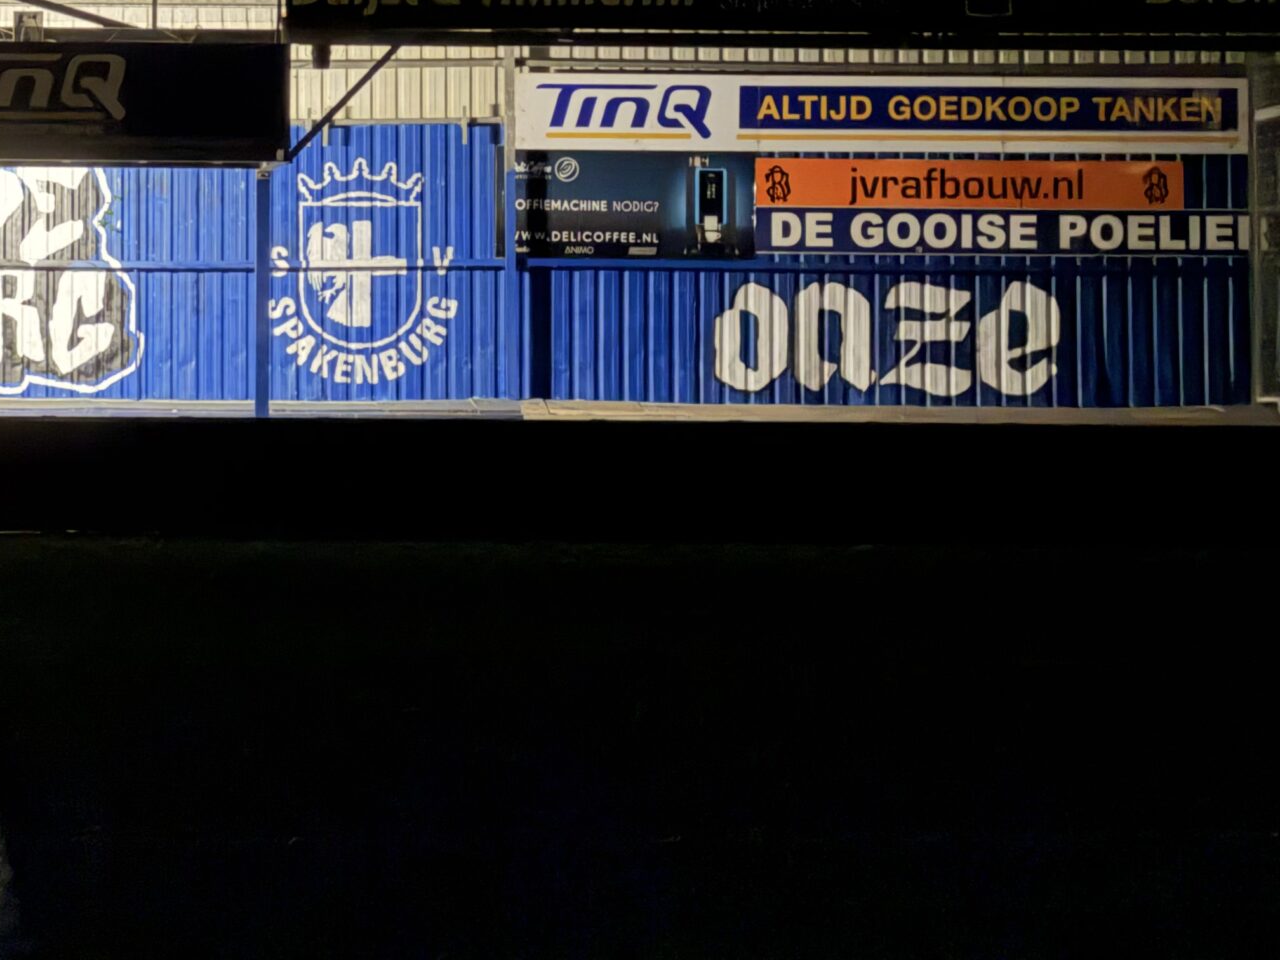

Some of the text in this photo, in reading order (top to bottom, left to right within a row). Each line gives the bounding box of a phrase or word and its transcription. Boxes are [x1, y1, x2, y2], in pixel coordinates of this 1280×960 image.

[536, 83, 712, 139] TinQ
[756, 95, 1222, 122] ALTIJD GOEDKOOP TANKEN
[515, 198, 660, 213] OFFIEMACHINE NODIG?
[849, 167, 1085, 206] jvrafbouw.nl
[770, 212, 834, 248] DE
[850, 213, 1038, 249] GOOISE
[269, 296, 458, 385] SPAKENBURG
[715, 280, 1061, 398] onze
